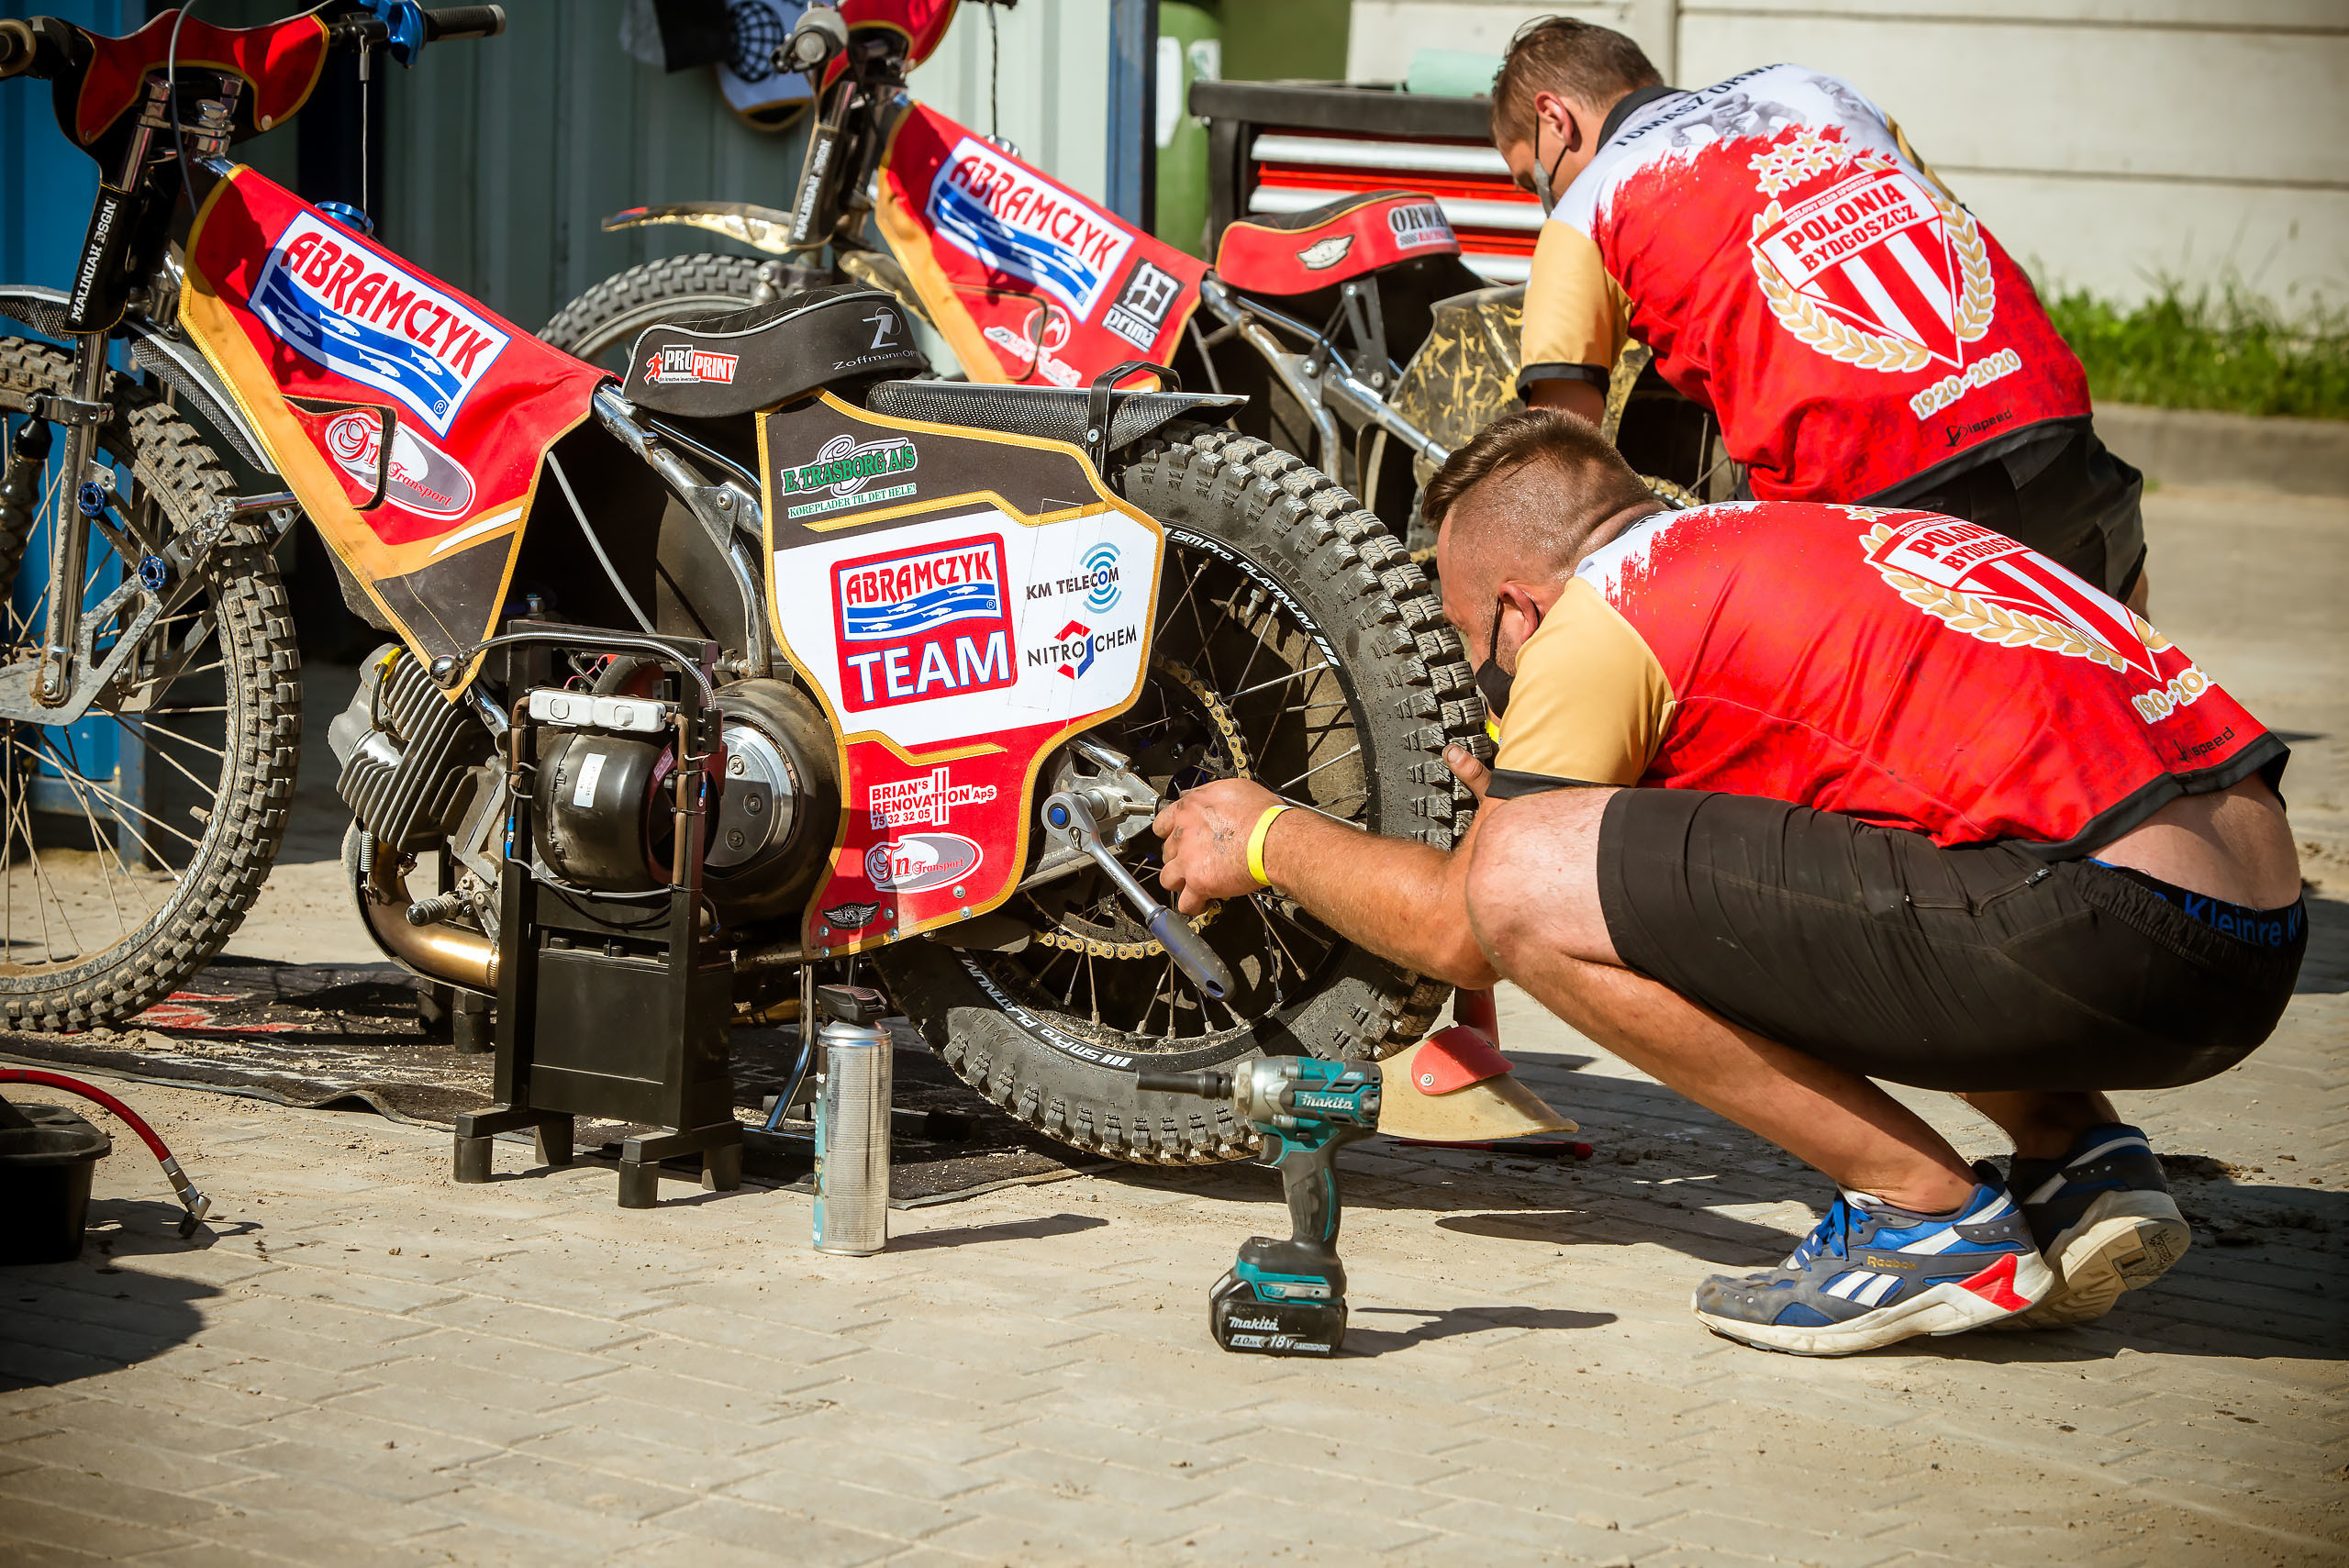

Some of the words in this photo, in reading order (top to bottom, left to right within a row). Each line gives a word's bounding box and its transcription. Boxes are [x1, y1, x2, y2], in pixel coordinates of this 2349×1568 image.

[949, 155, 1119, 272] ABRAMCZYK
[1781, 183, 1907, 255] POLONIA
[1799, 204, 1919, 272] BYDGOSZCZ
[281, 231, 494, 380] ABRAMCZYK
[693, 355, 736, 381] PRINT
[1912, 350, 2021, 418] 1920-2020
[888, 445, 916, 473] A/S
[389, 462, 454, 506] Transport
[789, 497, 851, 518] KØREPLADER
[852, 495, 867, 506] TIL
[868, 489, 886, 503] DET
[888, 484, 917, 498] HELE!
[846, 550, 993, 606] ABRAMCZYK
[1026, 583, 1052, 600] KM
[1056, 567, 1119, 595] TELECOM
[1237, 562, 1318, 630] PLATINUM
[846, 630, 1010, 703] TEAM
[872, 780, 929, 801] BRIAN'S
[872, 787, 970, 816] RENOVATION
[973, 787, 995, 801] ApS
[873, 816, 885, 828] 75
[887, 814, 900, 825] 32
[903, 811, 915, 822] 32
[918, 808, 930, 819] 05
[911, 857, 964, 875] Transport
[962, 959, 1038, 1029] PLATINUM
[1867, 1255, 1918, 1271] Reebok
